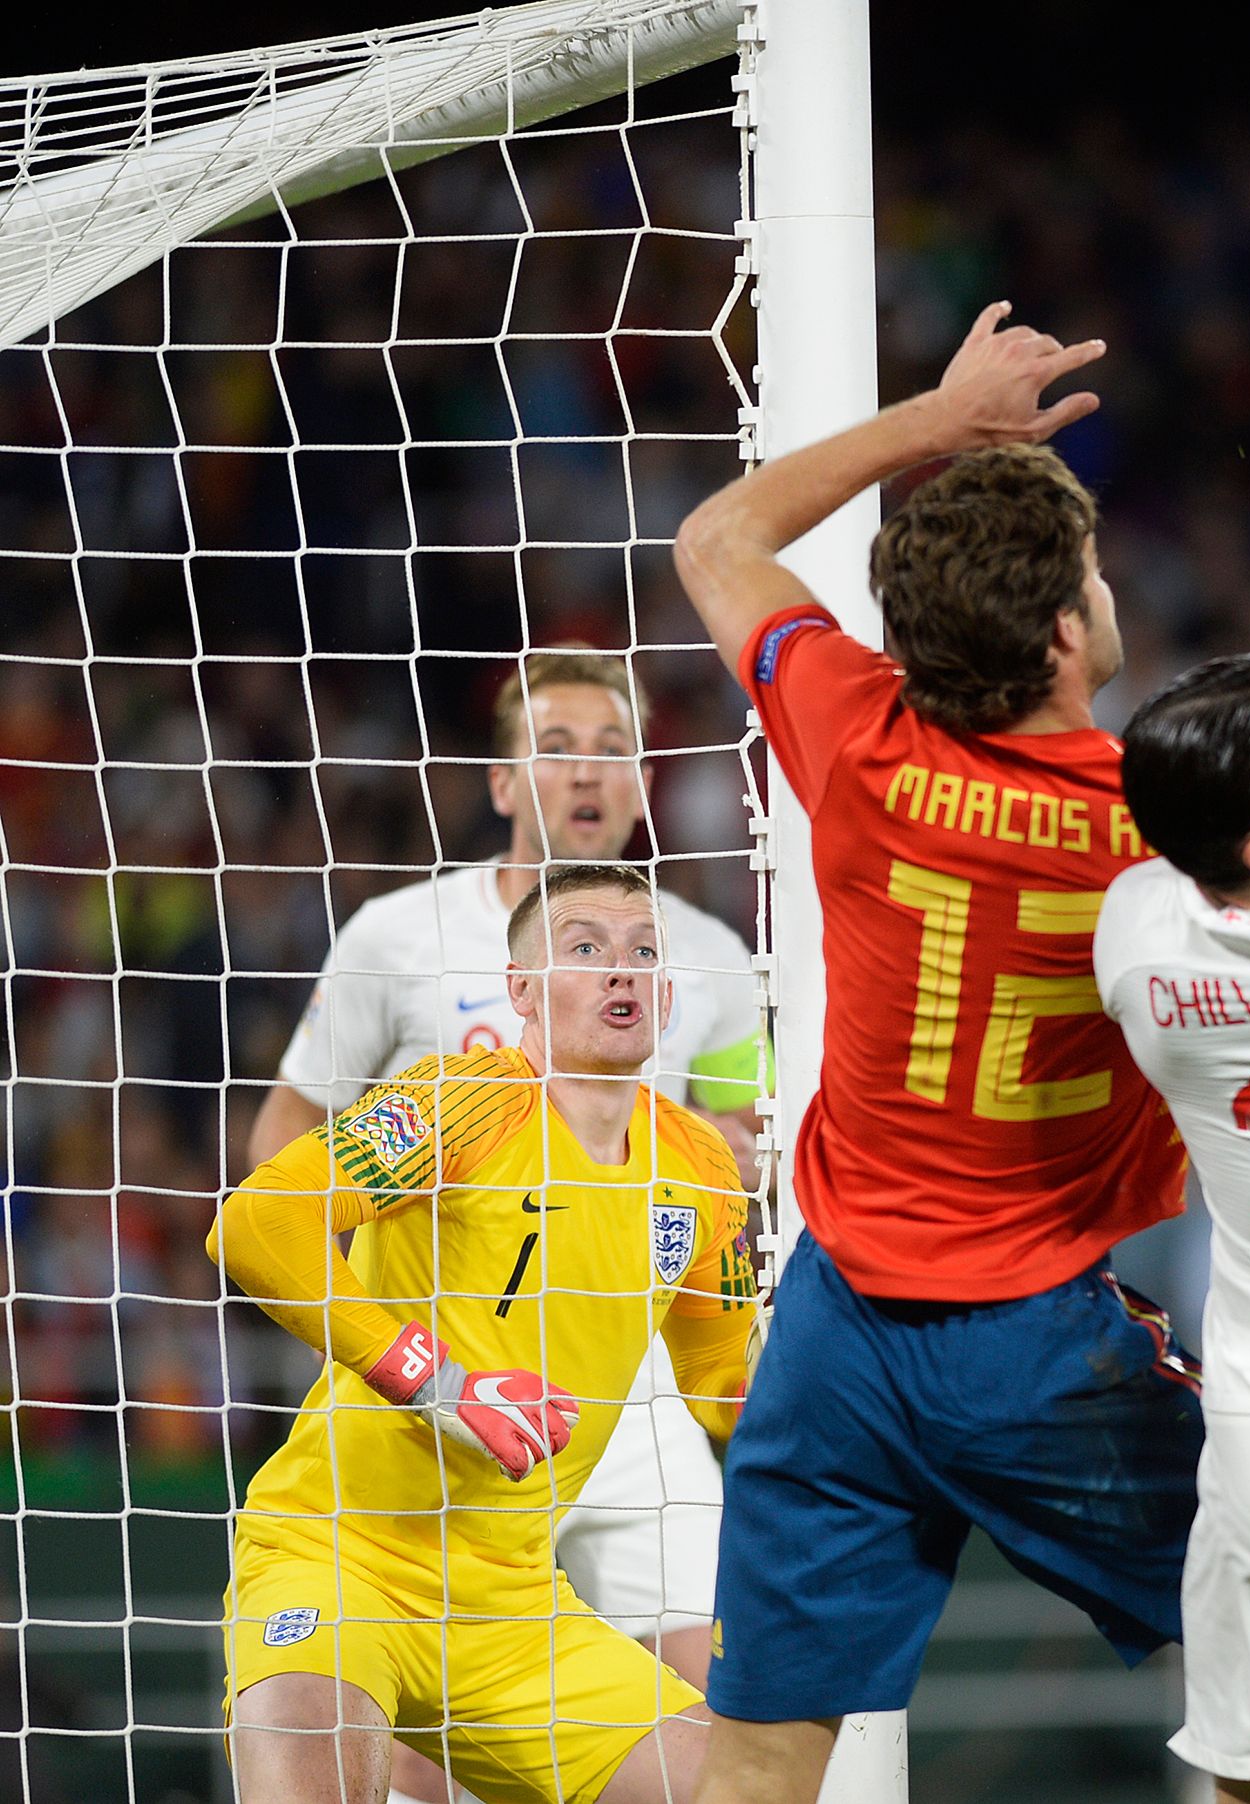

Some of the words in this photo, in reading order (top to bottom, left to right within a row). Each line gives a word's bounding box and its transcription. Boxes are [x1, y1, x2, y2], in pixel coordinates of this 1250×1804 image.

[884, 763, 1091, 853] MARCOS
[887, 859, 1113, 1122] 12
[495, 1232, 539, 1318] 1
[401, 1332, 433, 1380] JP
